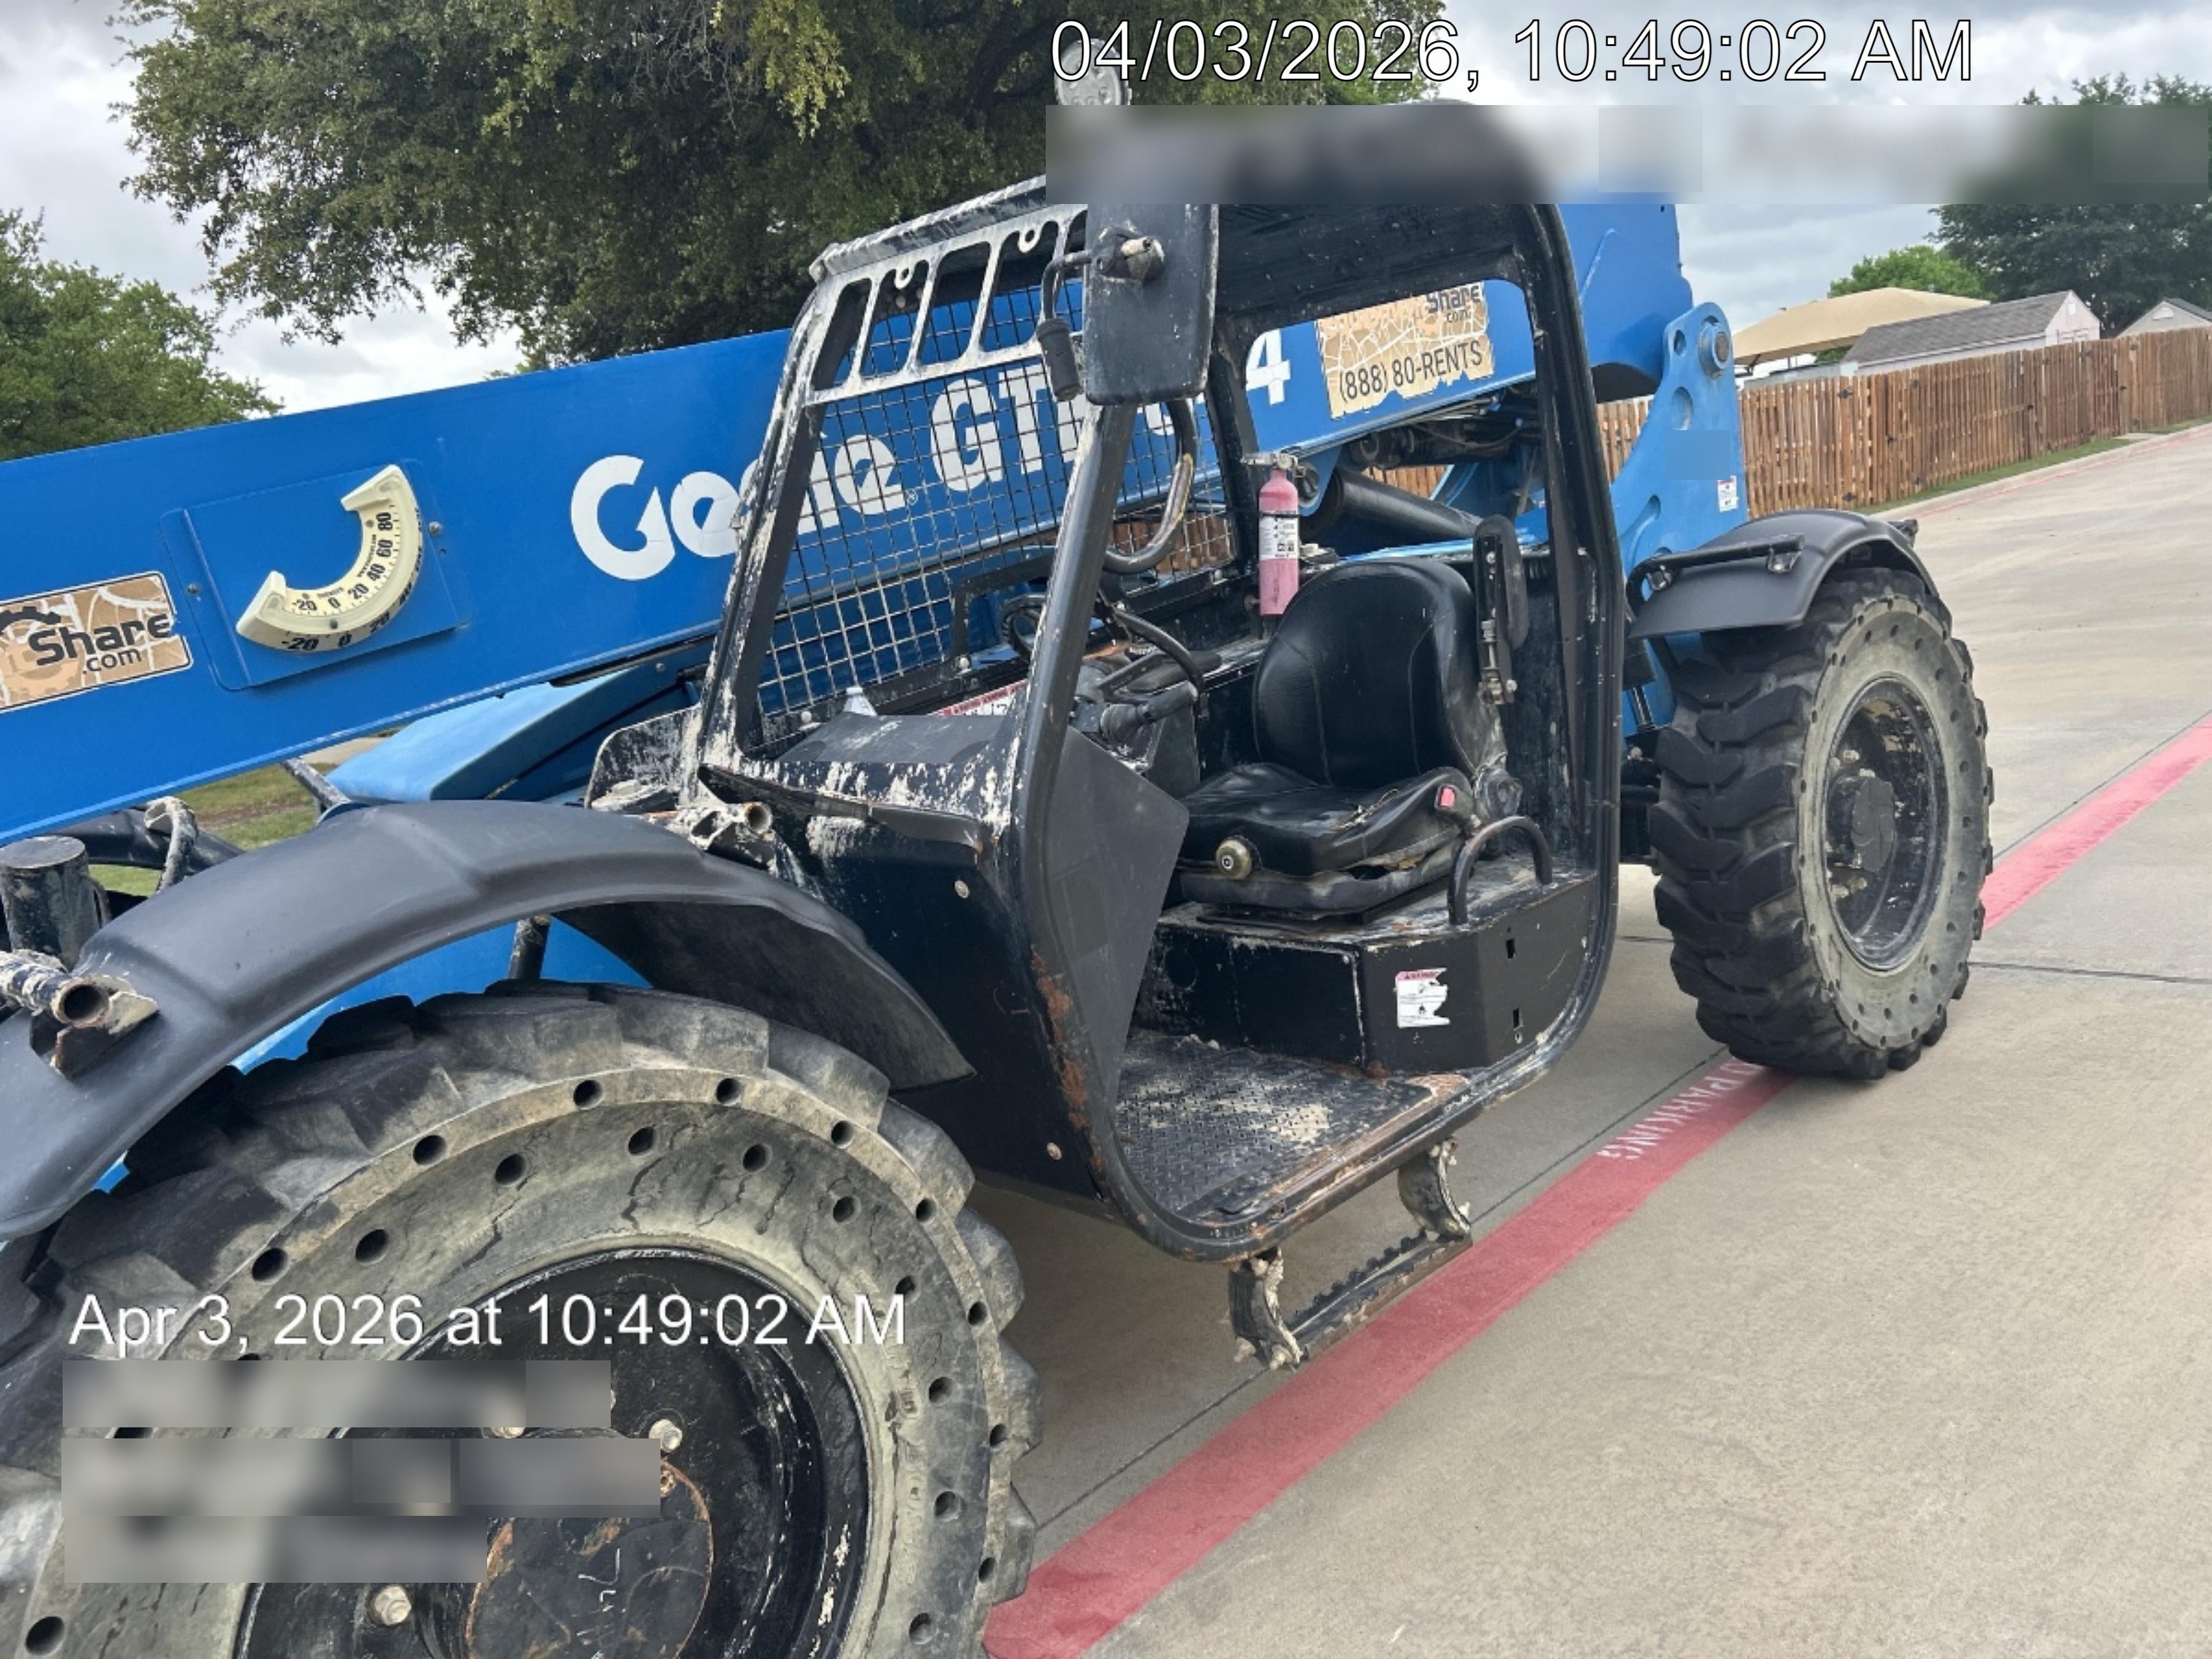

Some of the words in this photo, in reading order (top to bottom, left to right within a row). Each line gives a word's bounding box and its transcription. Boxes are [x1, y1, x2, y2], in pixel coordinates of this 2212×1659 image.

[1341, 363, 1388, 404] (888)
[1392, 340, 1482, 387] 80-RENTS
[376, 512, 393, 531] 80
[376, 539, 393, 557] 60
[367, 563, 385, 581] 40
[348, 584, 369, 599] 20
[328, 597, 341, 608] 0
[28, 614, 170, 666] Share
[281, 637, 319, 651] -20
[338, 633, 352, 647] 0
[83, 648, 141, 675] .com
[1596, 1076, 1745, 1160] PARKING
